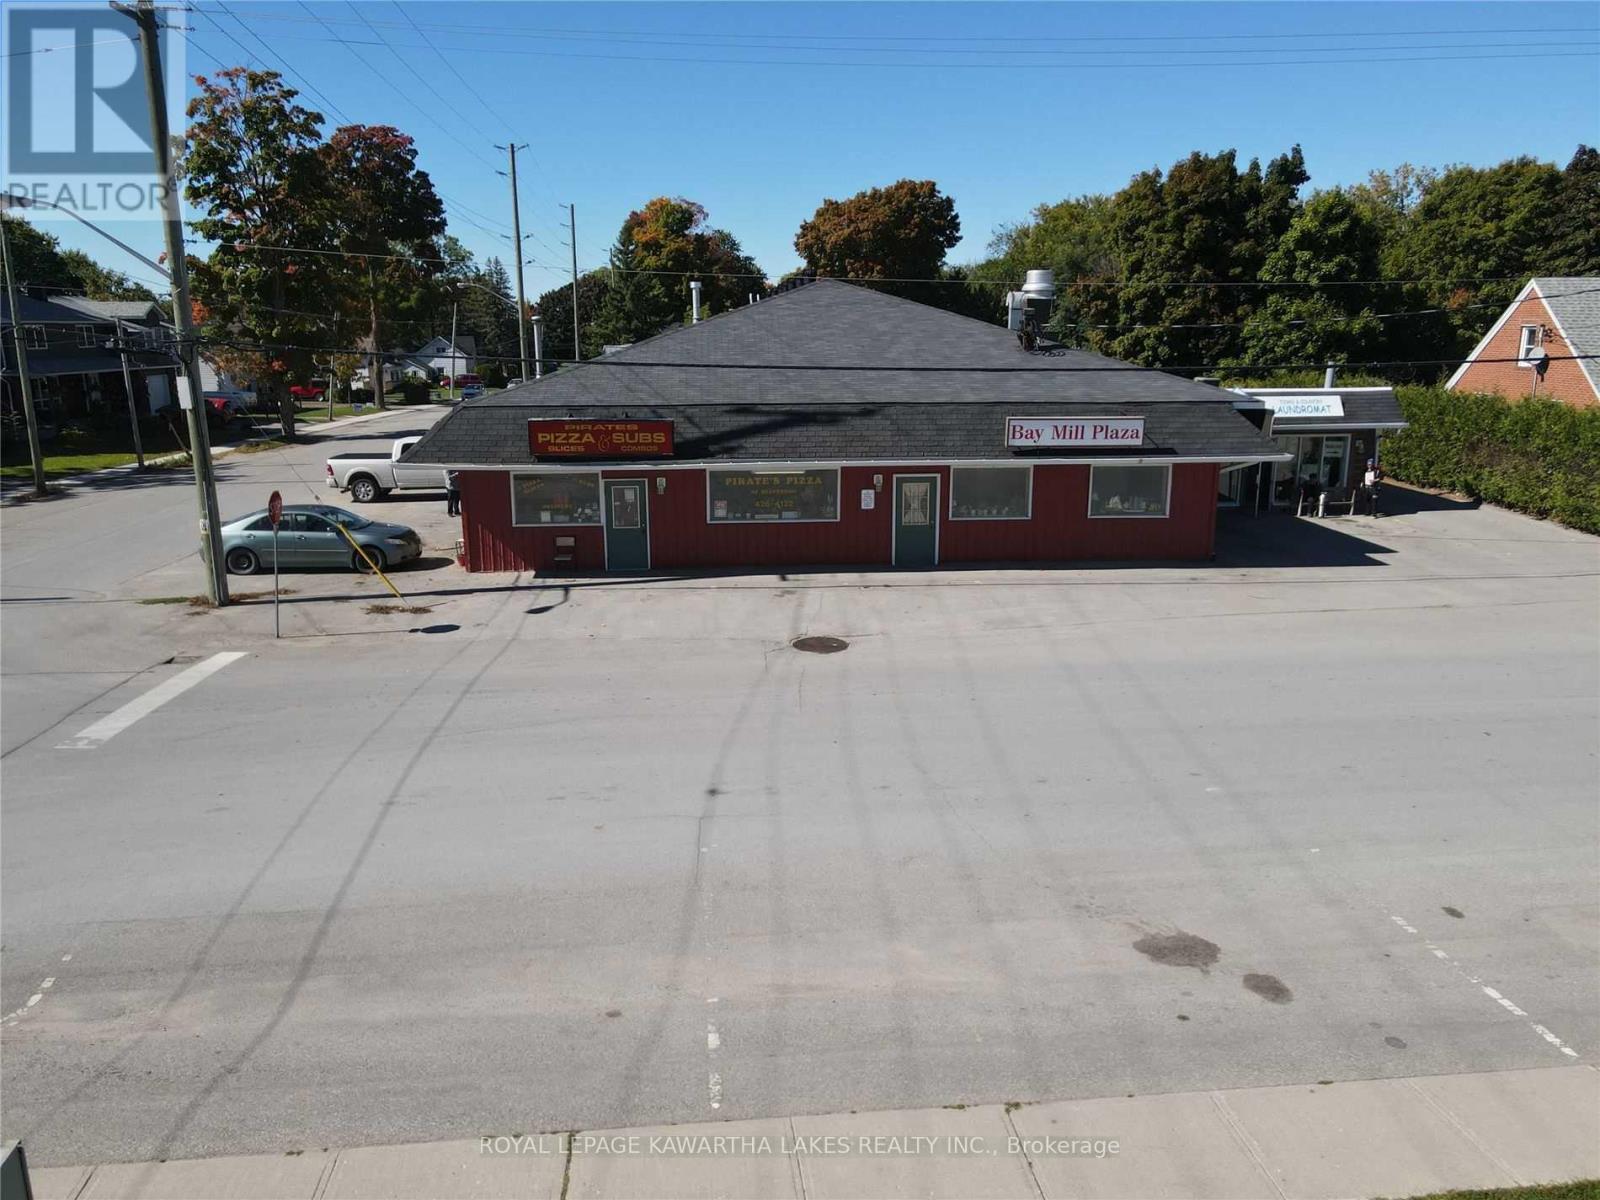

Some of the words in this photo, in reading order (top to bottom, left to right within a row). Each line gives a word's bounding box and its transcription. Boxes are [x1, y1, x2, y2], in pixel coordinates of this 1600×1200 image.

[537, 432, 596, 444] PIZZA
[612, 432, 666, 443] SUBS
[1011, 424, 1044, 443] Bay
[1052, 424, 1085, 440] Mill
[1092, 424, 1140, 440] Plaza
[786, 476, 823, 485] PIZZA
